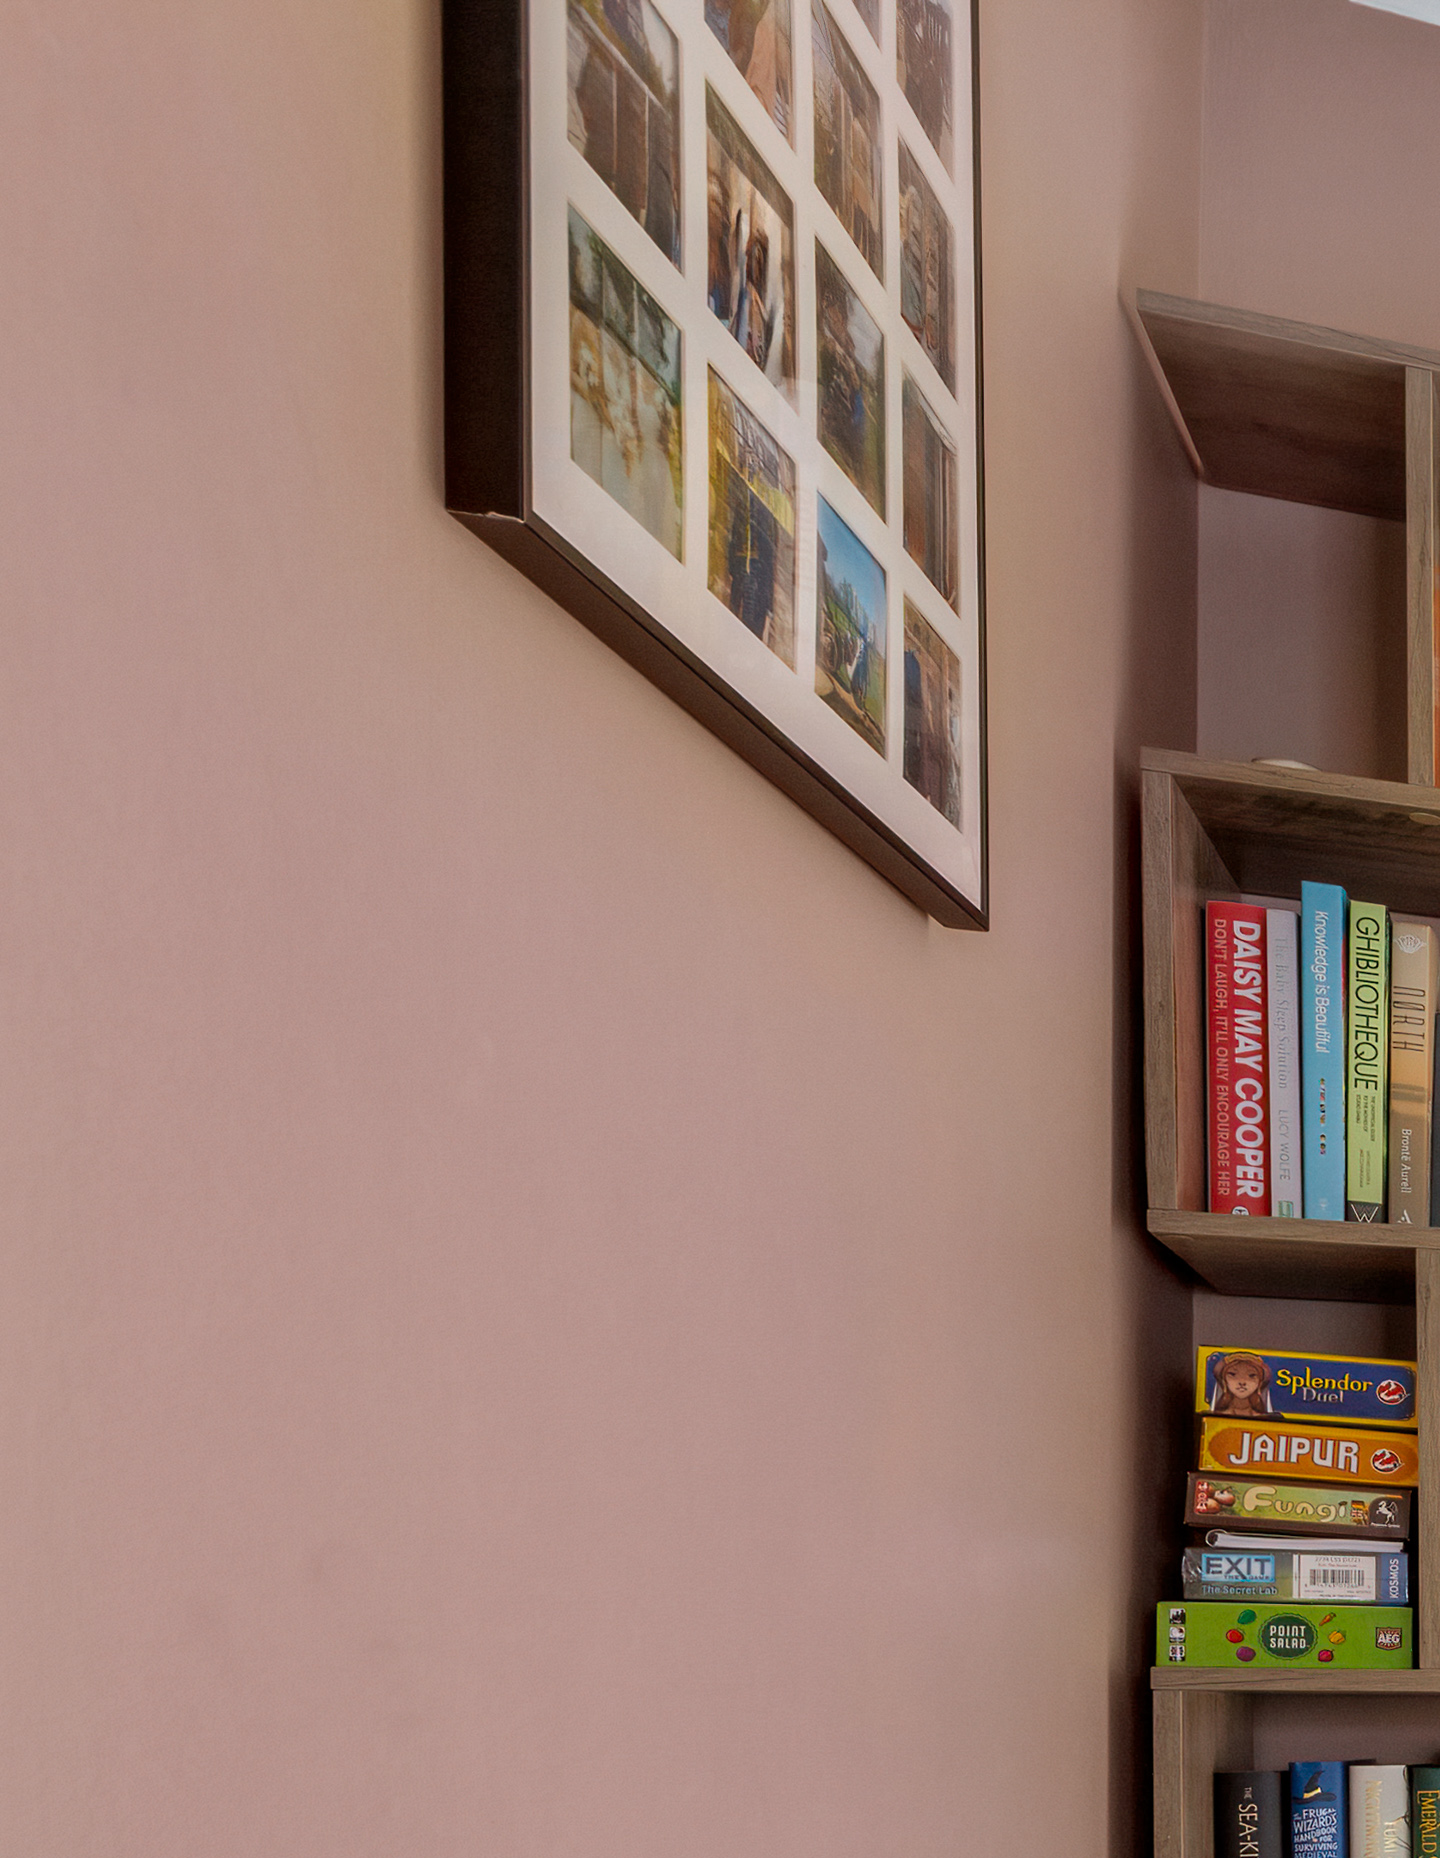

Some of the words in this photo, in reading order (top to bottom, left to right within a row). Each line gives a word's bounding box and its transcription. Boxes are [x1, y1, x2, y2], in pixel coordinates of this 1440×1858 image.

[1213, 919, 1227, 961] DON'T
[1312, 910, 1331, 982] Knowledge
[1233, 920, 1262, 1004] DAISY
[1212, 963, 1228, 1014] LAUGH,
[1315, 985, 1330, 995] is
[1353, 916, 1381, 1091] GHIBLIOTHEQUE
[1214, 1016, 1228, 1044] IT'LL
[1233, 1007, 1262, 1073] MAY
[1314, 997, 1331, 1054] Beautiful
[1215, 1048, 1228, 1081] ONLY
[1216, 1085, 1230, 1167] ENCOURAGE
[1234, 1077, 1264, 1199] COOPER
[1279, 1110, 1291, 1138] LUCY
[1280, 1142, 1291, 1181] WOLFE
[1400, 1129, 1413, 1161] Brontë
[1218, 1172, 1230, 1196] HER
[1401, 1164, 1412, 1193] Aurell
[1275, 1366, 1373, 1396] Splendor
[1228, 1431, 1360, 1475] JAIPUR
[1242, 1485, 1347, 1520] Fungi
[1205, 1557, 1273, 1576] EXIT
[1388, 1558, 1399, 1600] KOSMOS
[1202, 1585, 1219, 1595] The
[1221, 1585, 1256, 1595] Secret
[1259, 1586, 1278, 1596] Lab
[1269, 1625, 1306, 1637] POINT
[1269, 1637, 1306, 1649] SALAD
[1377, 1634, 1400, 1646] AEG
[1417, 1790, 1440, 1853] EMERALD
